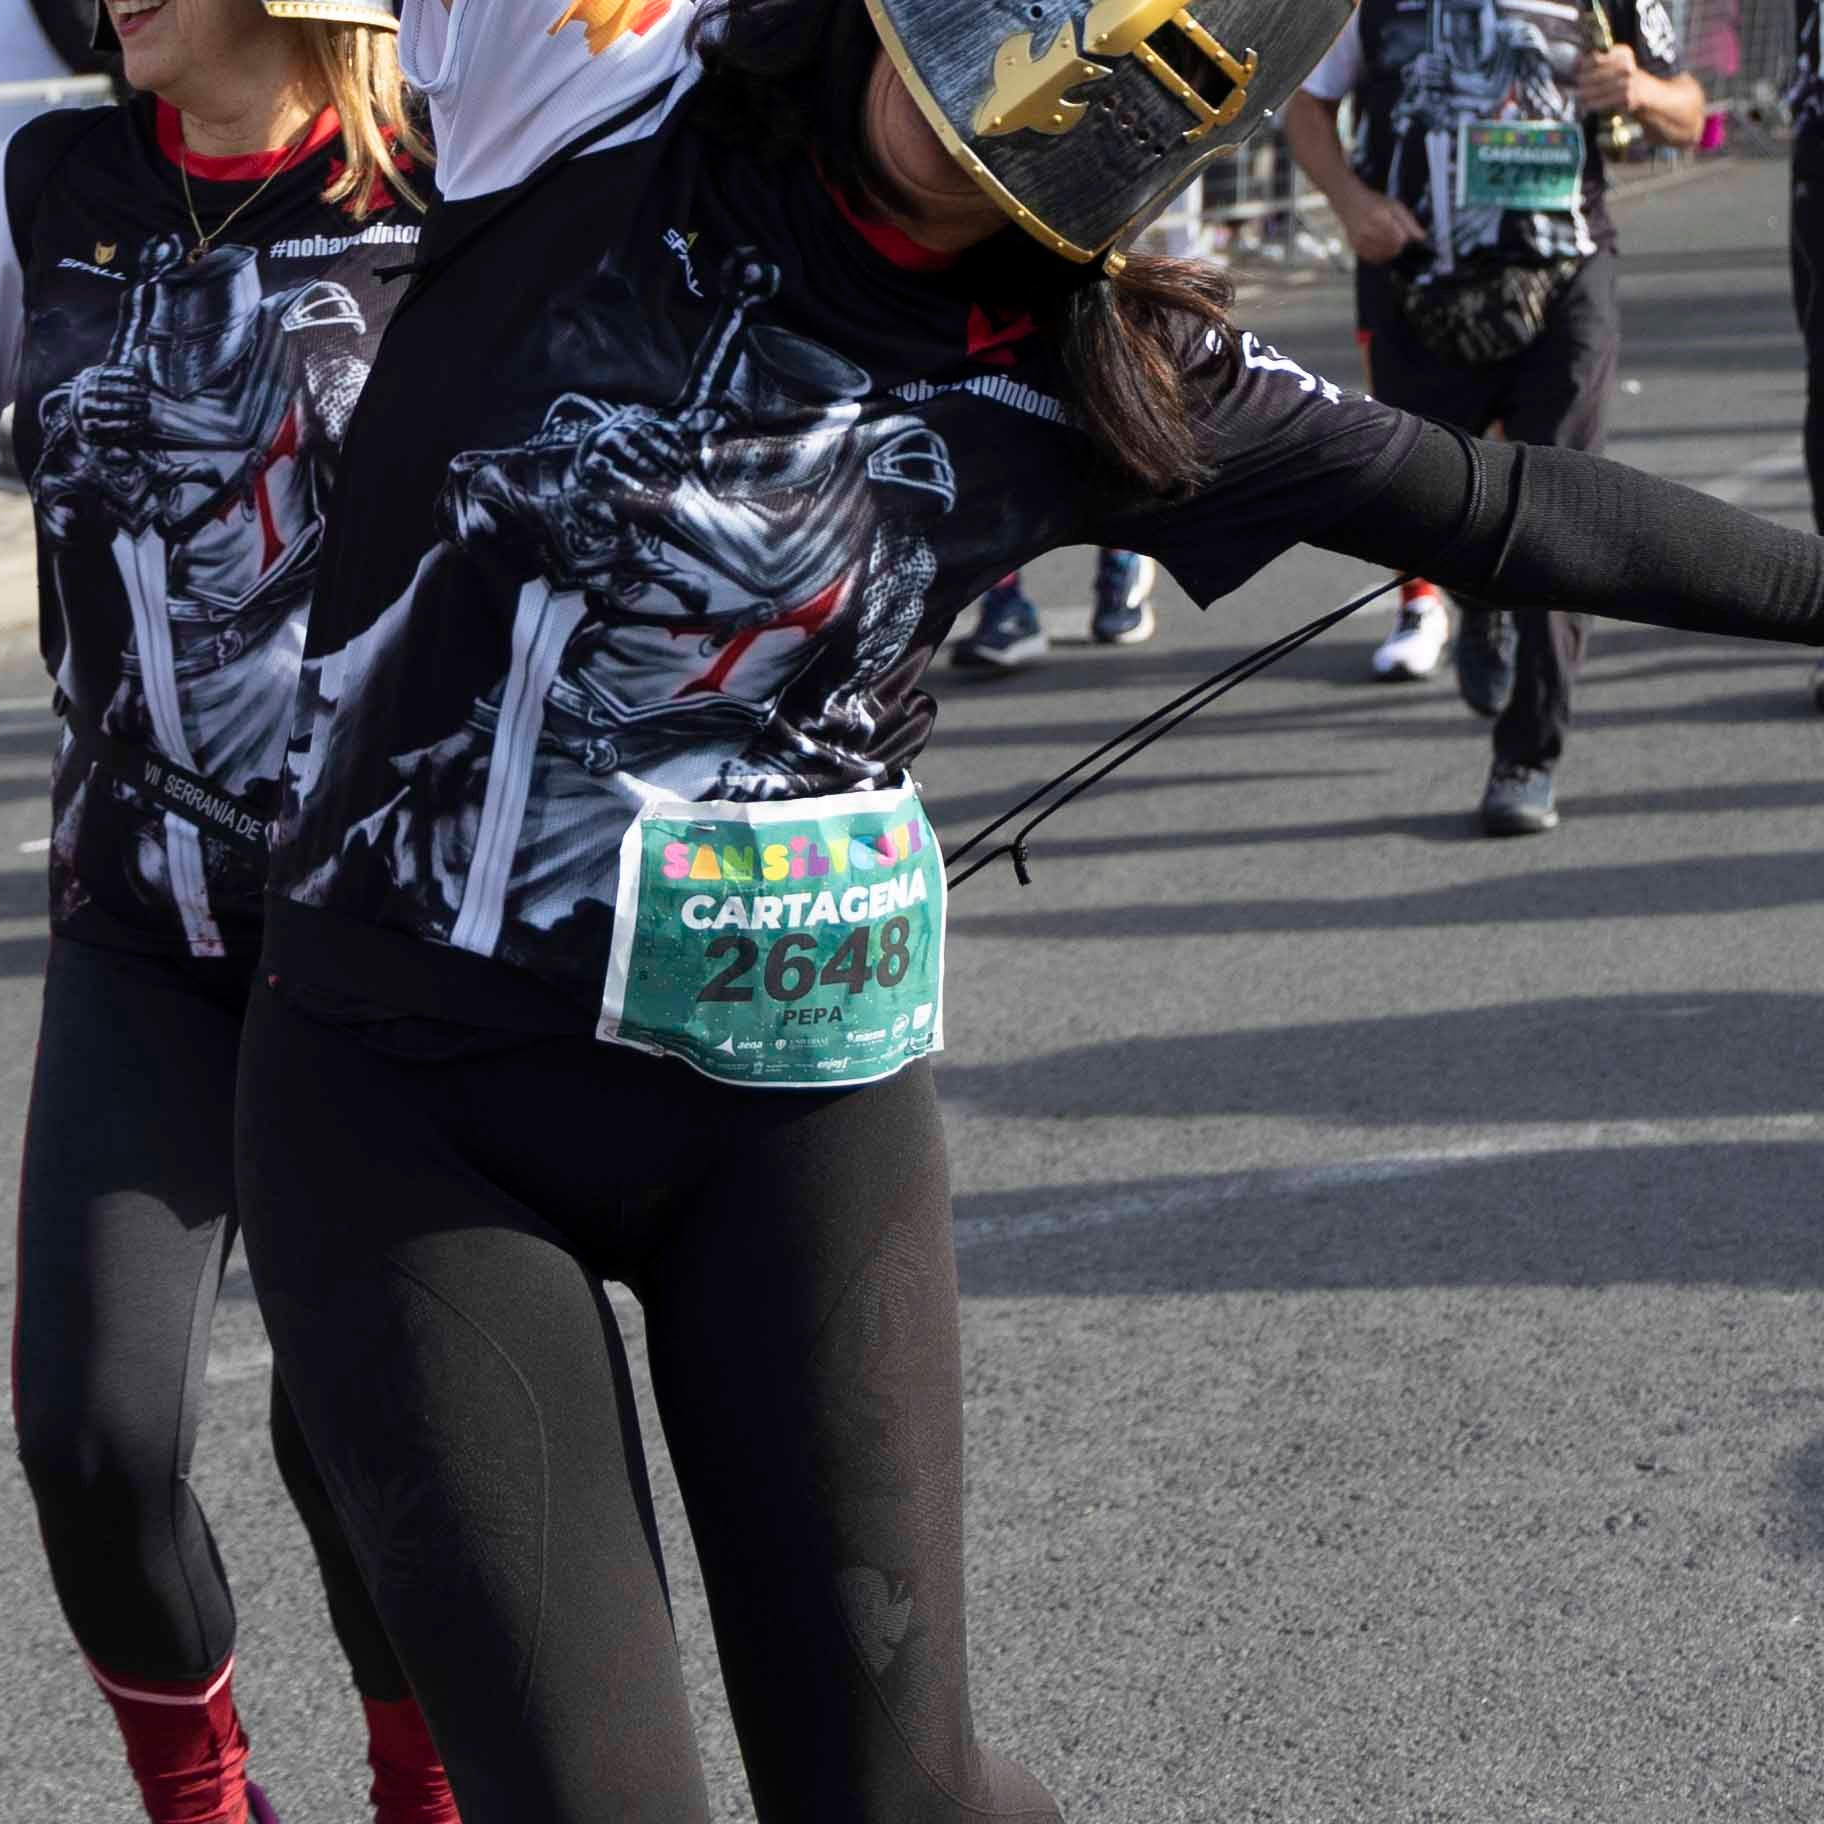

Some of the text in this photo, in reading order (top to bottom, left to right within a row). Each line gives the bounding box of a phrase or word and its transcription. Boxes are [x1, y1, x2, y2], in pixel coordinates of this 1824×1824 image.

[144, 759, 163, 786] VII
[163, 773, 239, 829] SERRANÍA
[234, 813, 263, 842] DE
[662, 840, 755, 881] SAN
[680, 867, 926, 930] CARTAGENA
[696, 915, 911, 1003] 2648
[783, 1005, 844, 1025] PEPA
